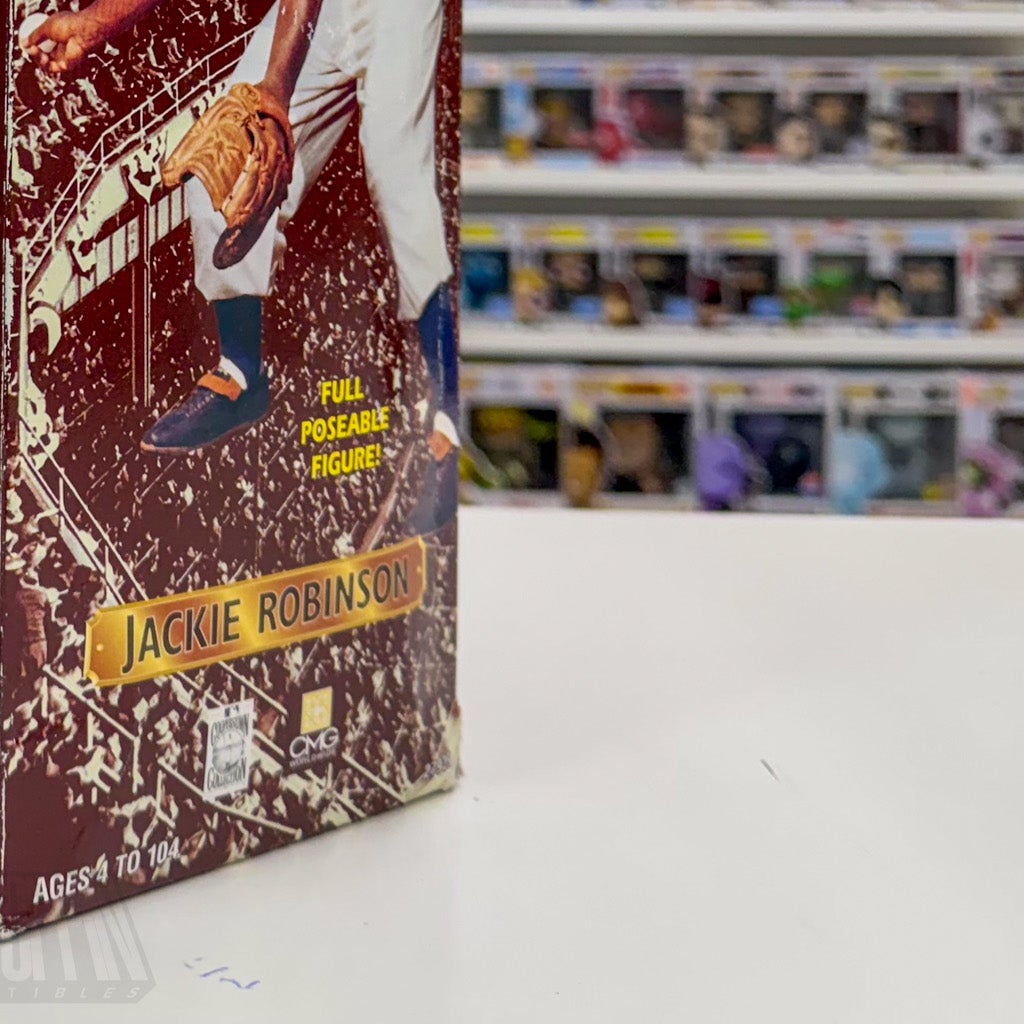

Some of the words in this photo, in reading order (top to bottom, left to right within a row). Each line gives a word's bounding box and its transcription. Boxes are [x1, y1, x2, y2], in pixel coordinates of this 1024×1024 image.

[321, 376, 365, 406] FULL
[301, 406, 390, 446] POSEABLE
[311, 443, 382, 480] FIGURE!
[121, 598, 241, 675] JACKIE
[258, 556, 409, 634] ROBINSON
[289, 726, 339, 759] CMG
[32, 865, 90, 905] AGES
[96, 859, 109, 885] 4
[116, 849, 141, 879] TO
[147, 835, 180, 868] 104
